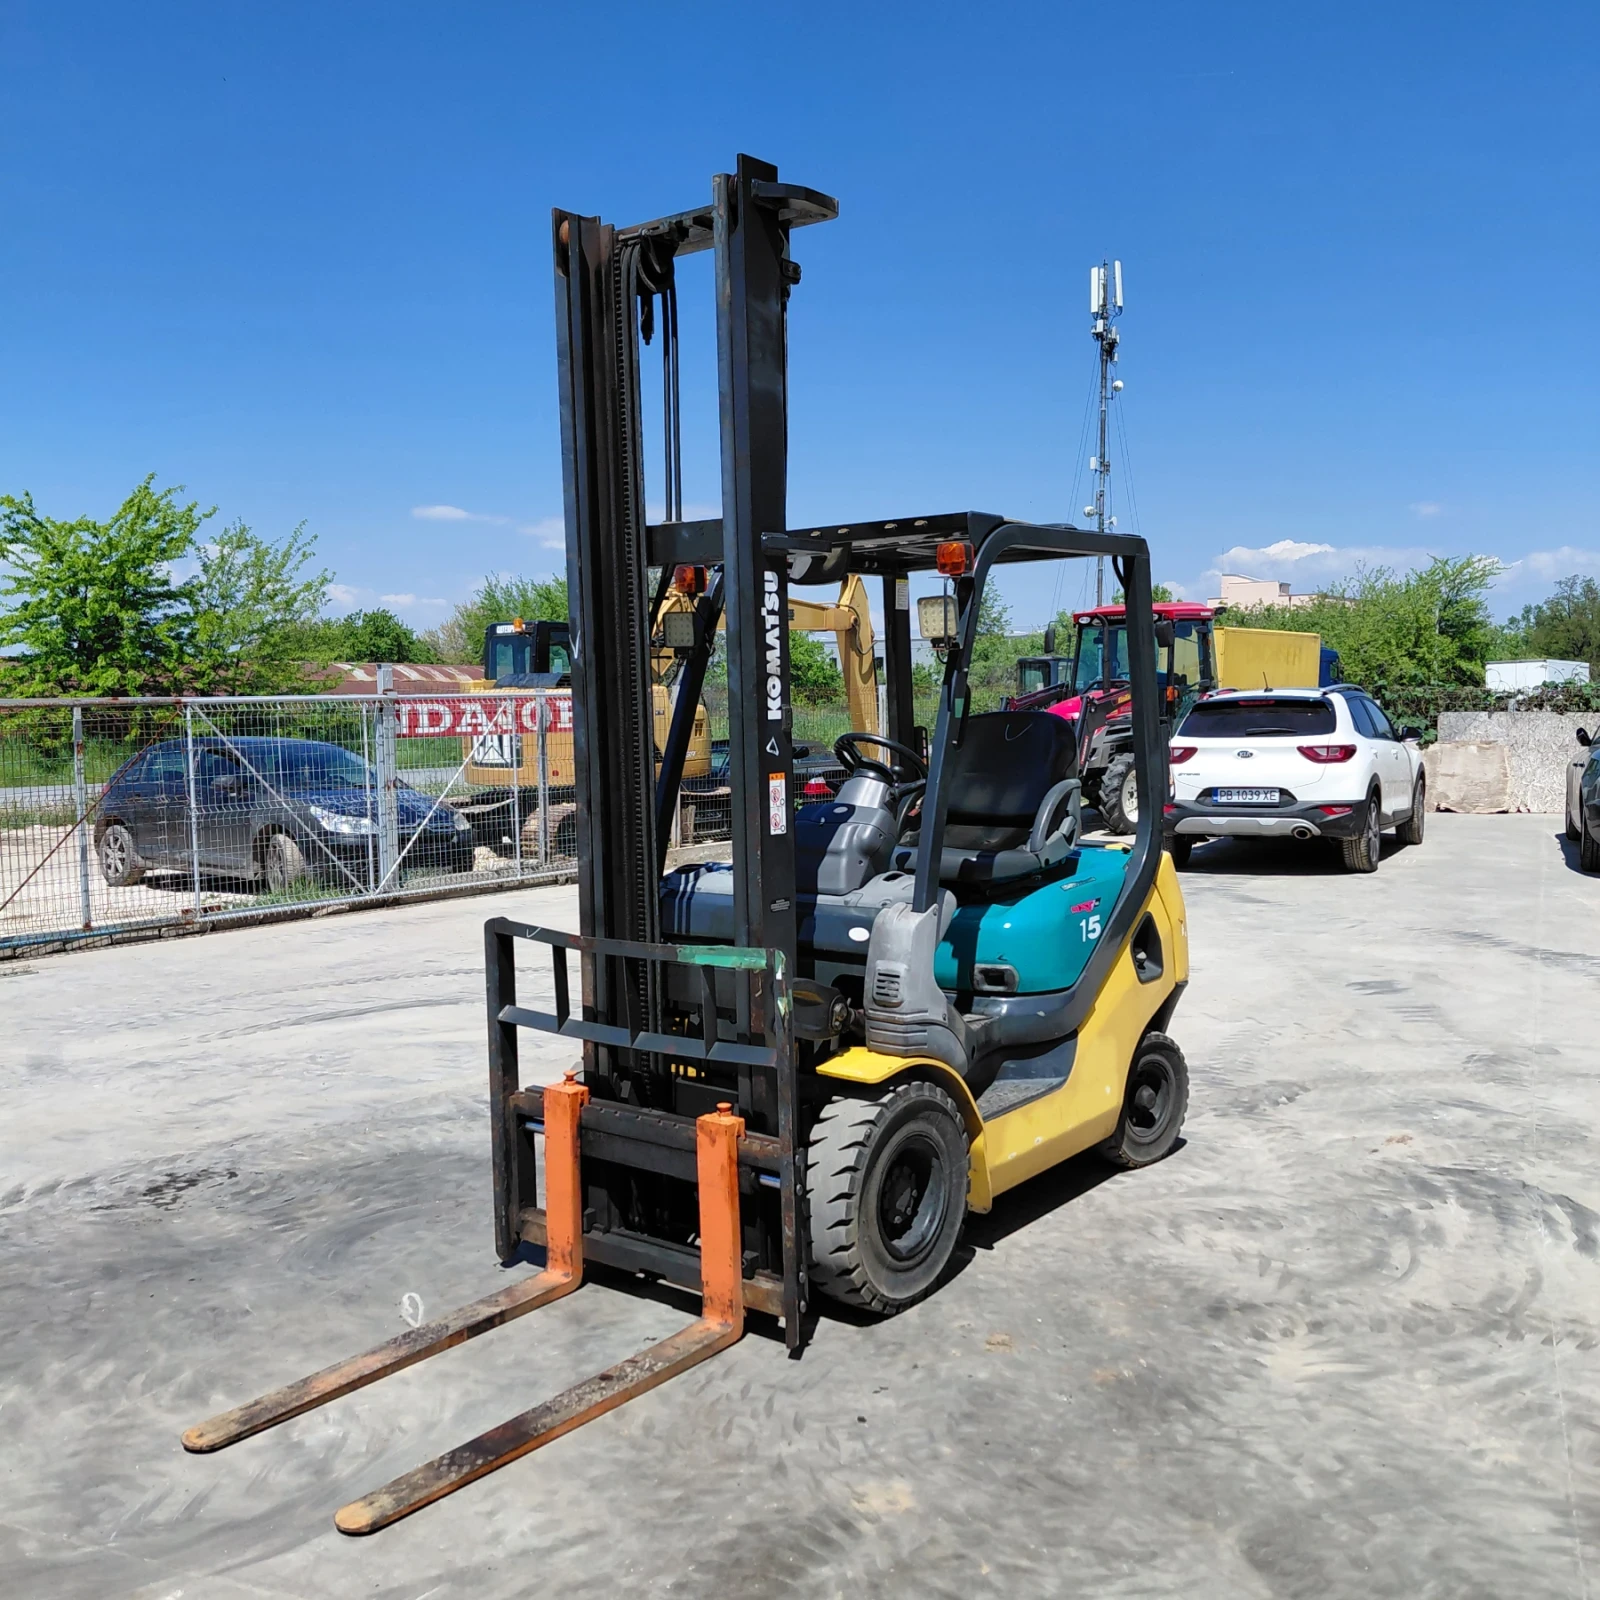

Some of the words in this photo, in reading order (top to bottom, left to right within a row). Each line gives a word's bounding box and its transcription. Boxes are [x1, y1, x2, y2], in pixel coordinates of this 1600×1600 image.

[761, 570, 782, 721] KOMATSU
[1219, 790, 1233, 801] PB
[1236, 790, 1260, 801] 1039
[1263, 790, 1277, 801] XE
[1079, 914, 1102, 942] 15
